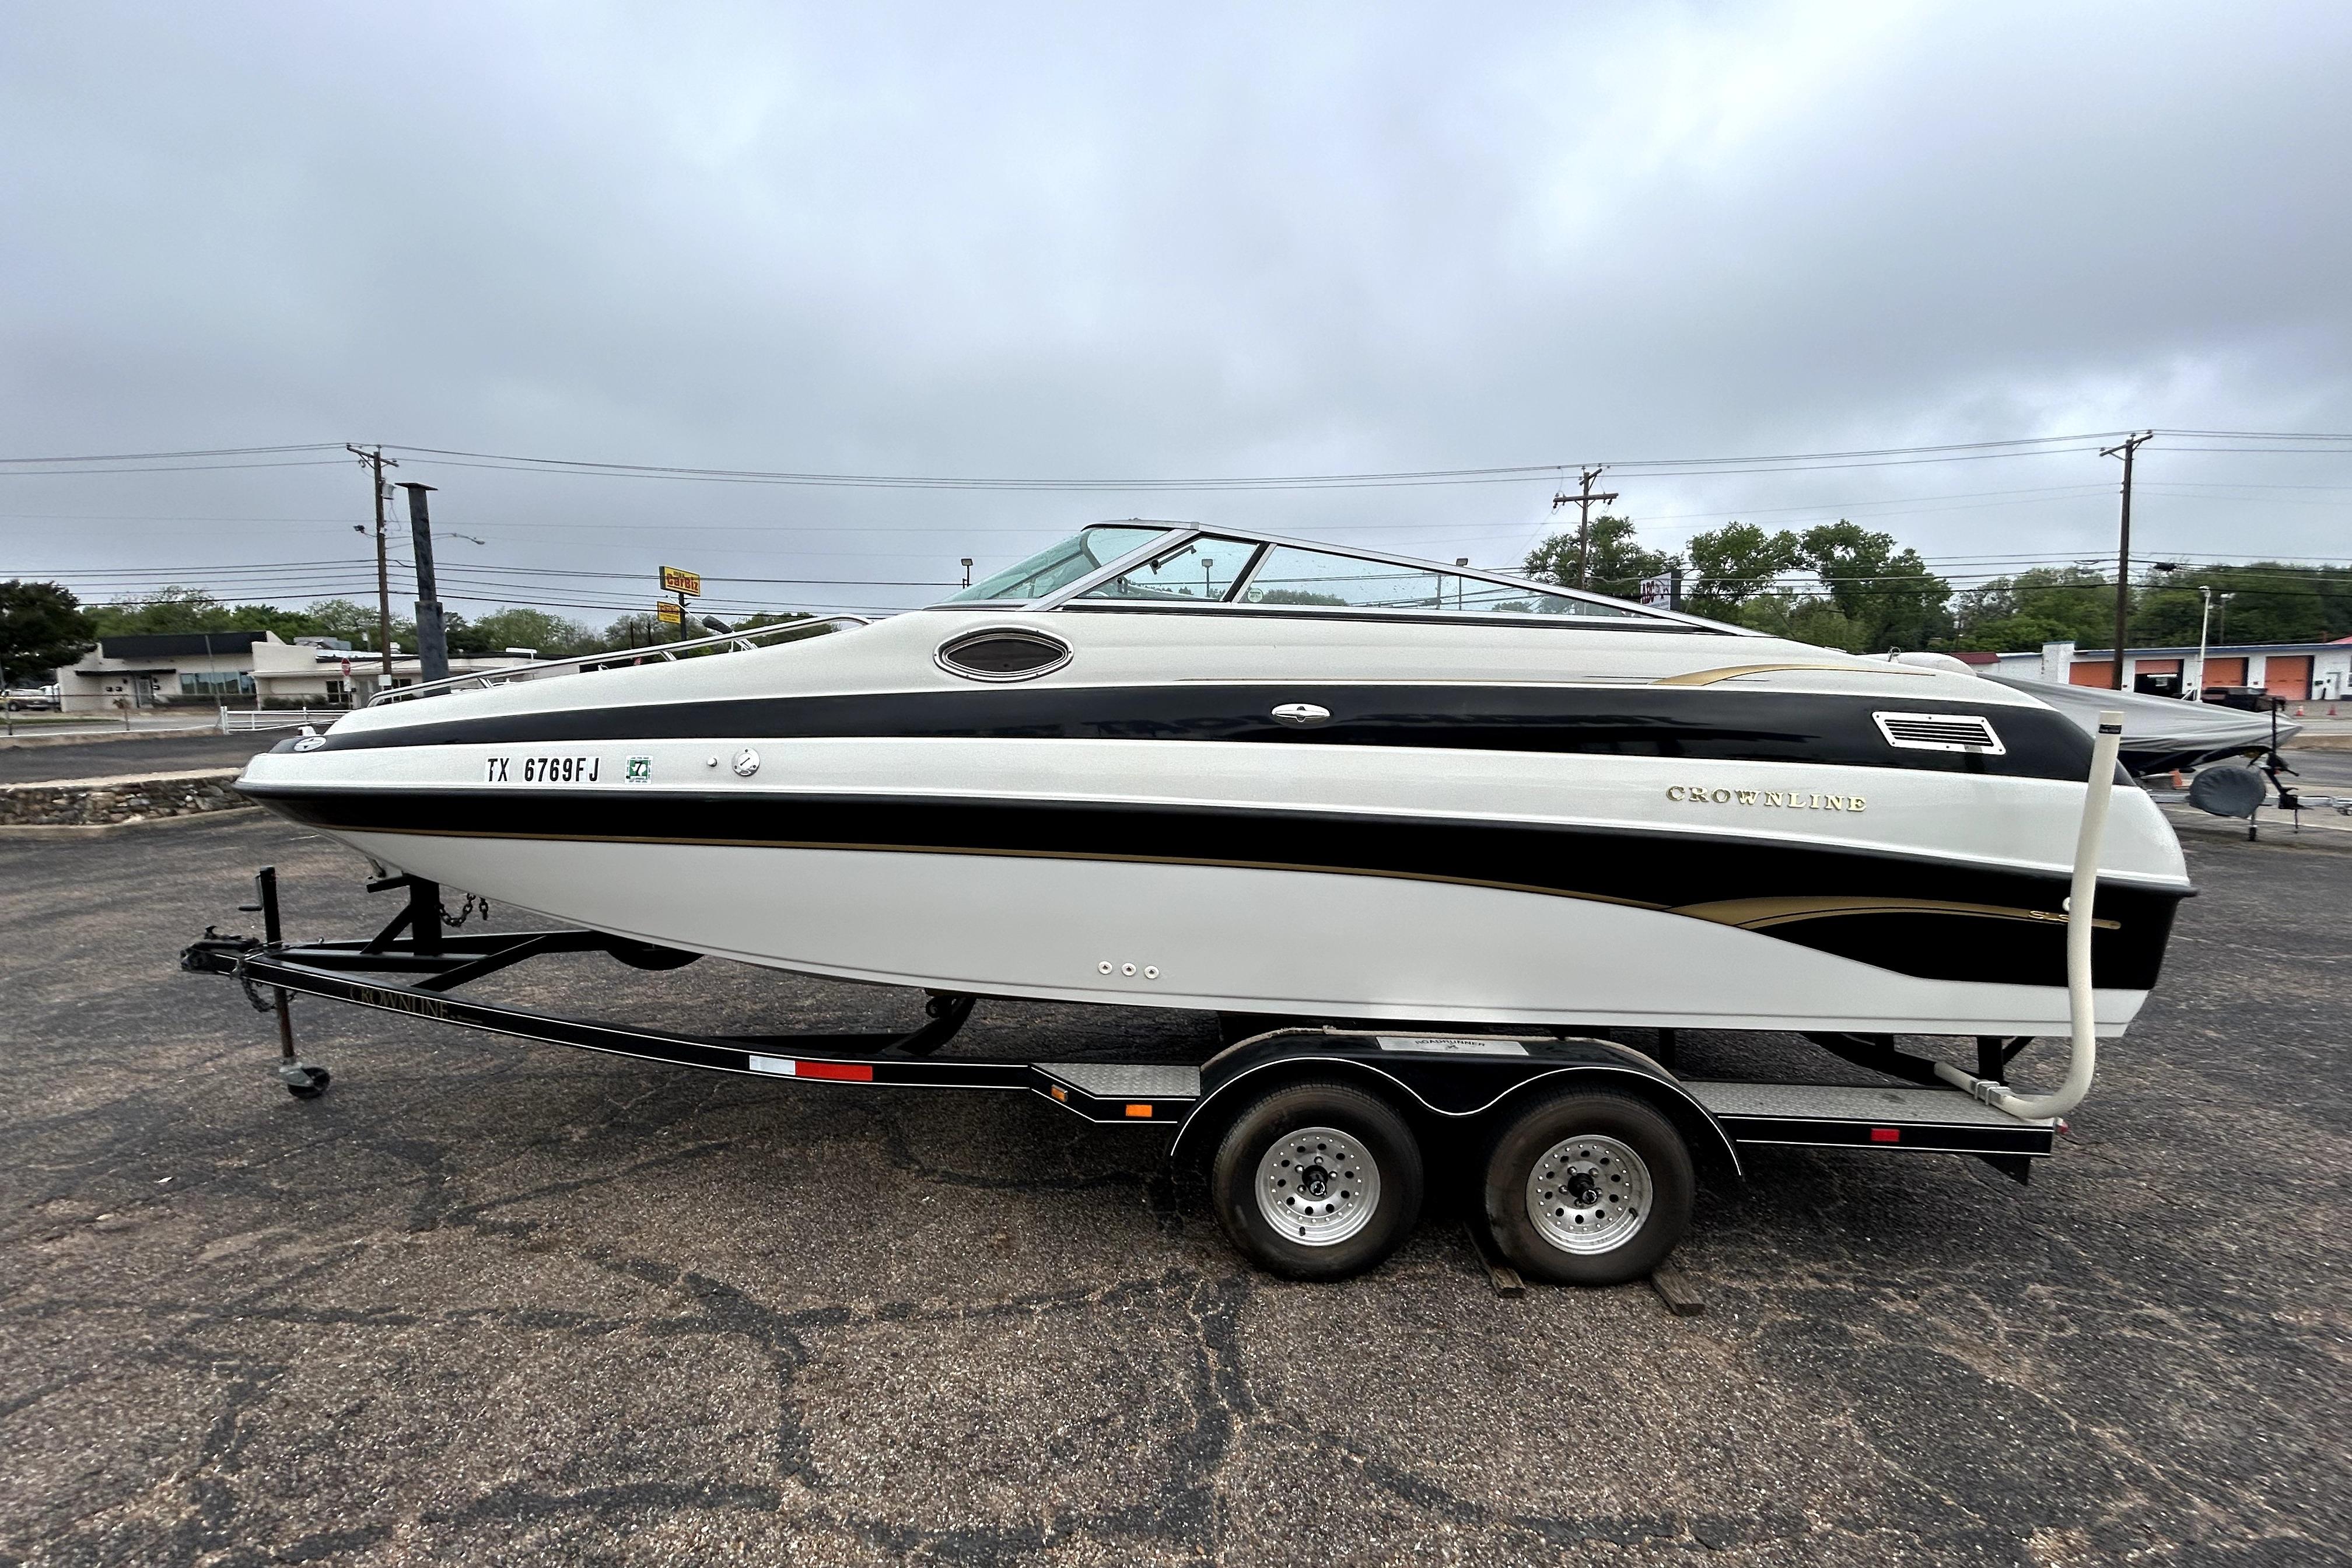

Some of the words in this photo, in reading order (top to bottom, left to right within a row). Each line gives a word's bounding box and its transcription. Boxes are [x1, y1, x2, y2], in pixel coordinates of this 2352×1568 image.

[488, 758, 509, 782] TX
[524, 758, 599, 782] 6769FJ
[1665, 785, 1867, 811] CROWNLINE
[350, 985, 449, 1020] CROWNLINE
